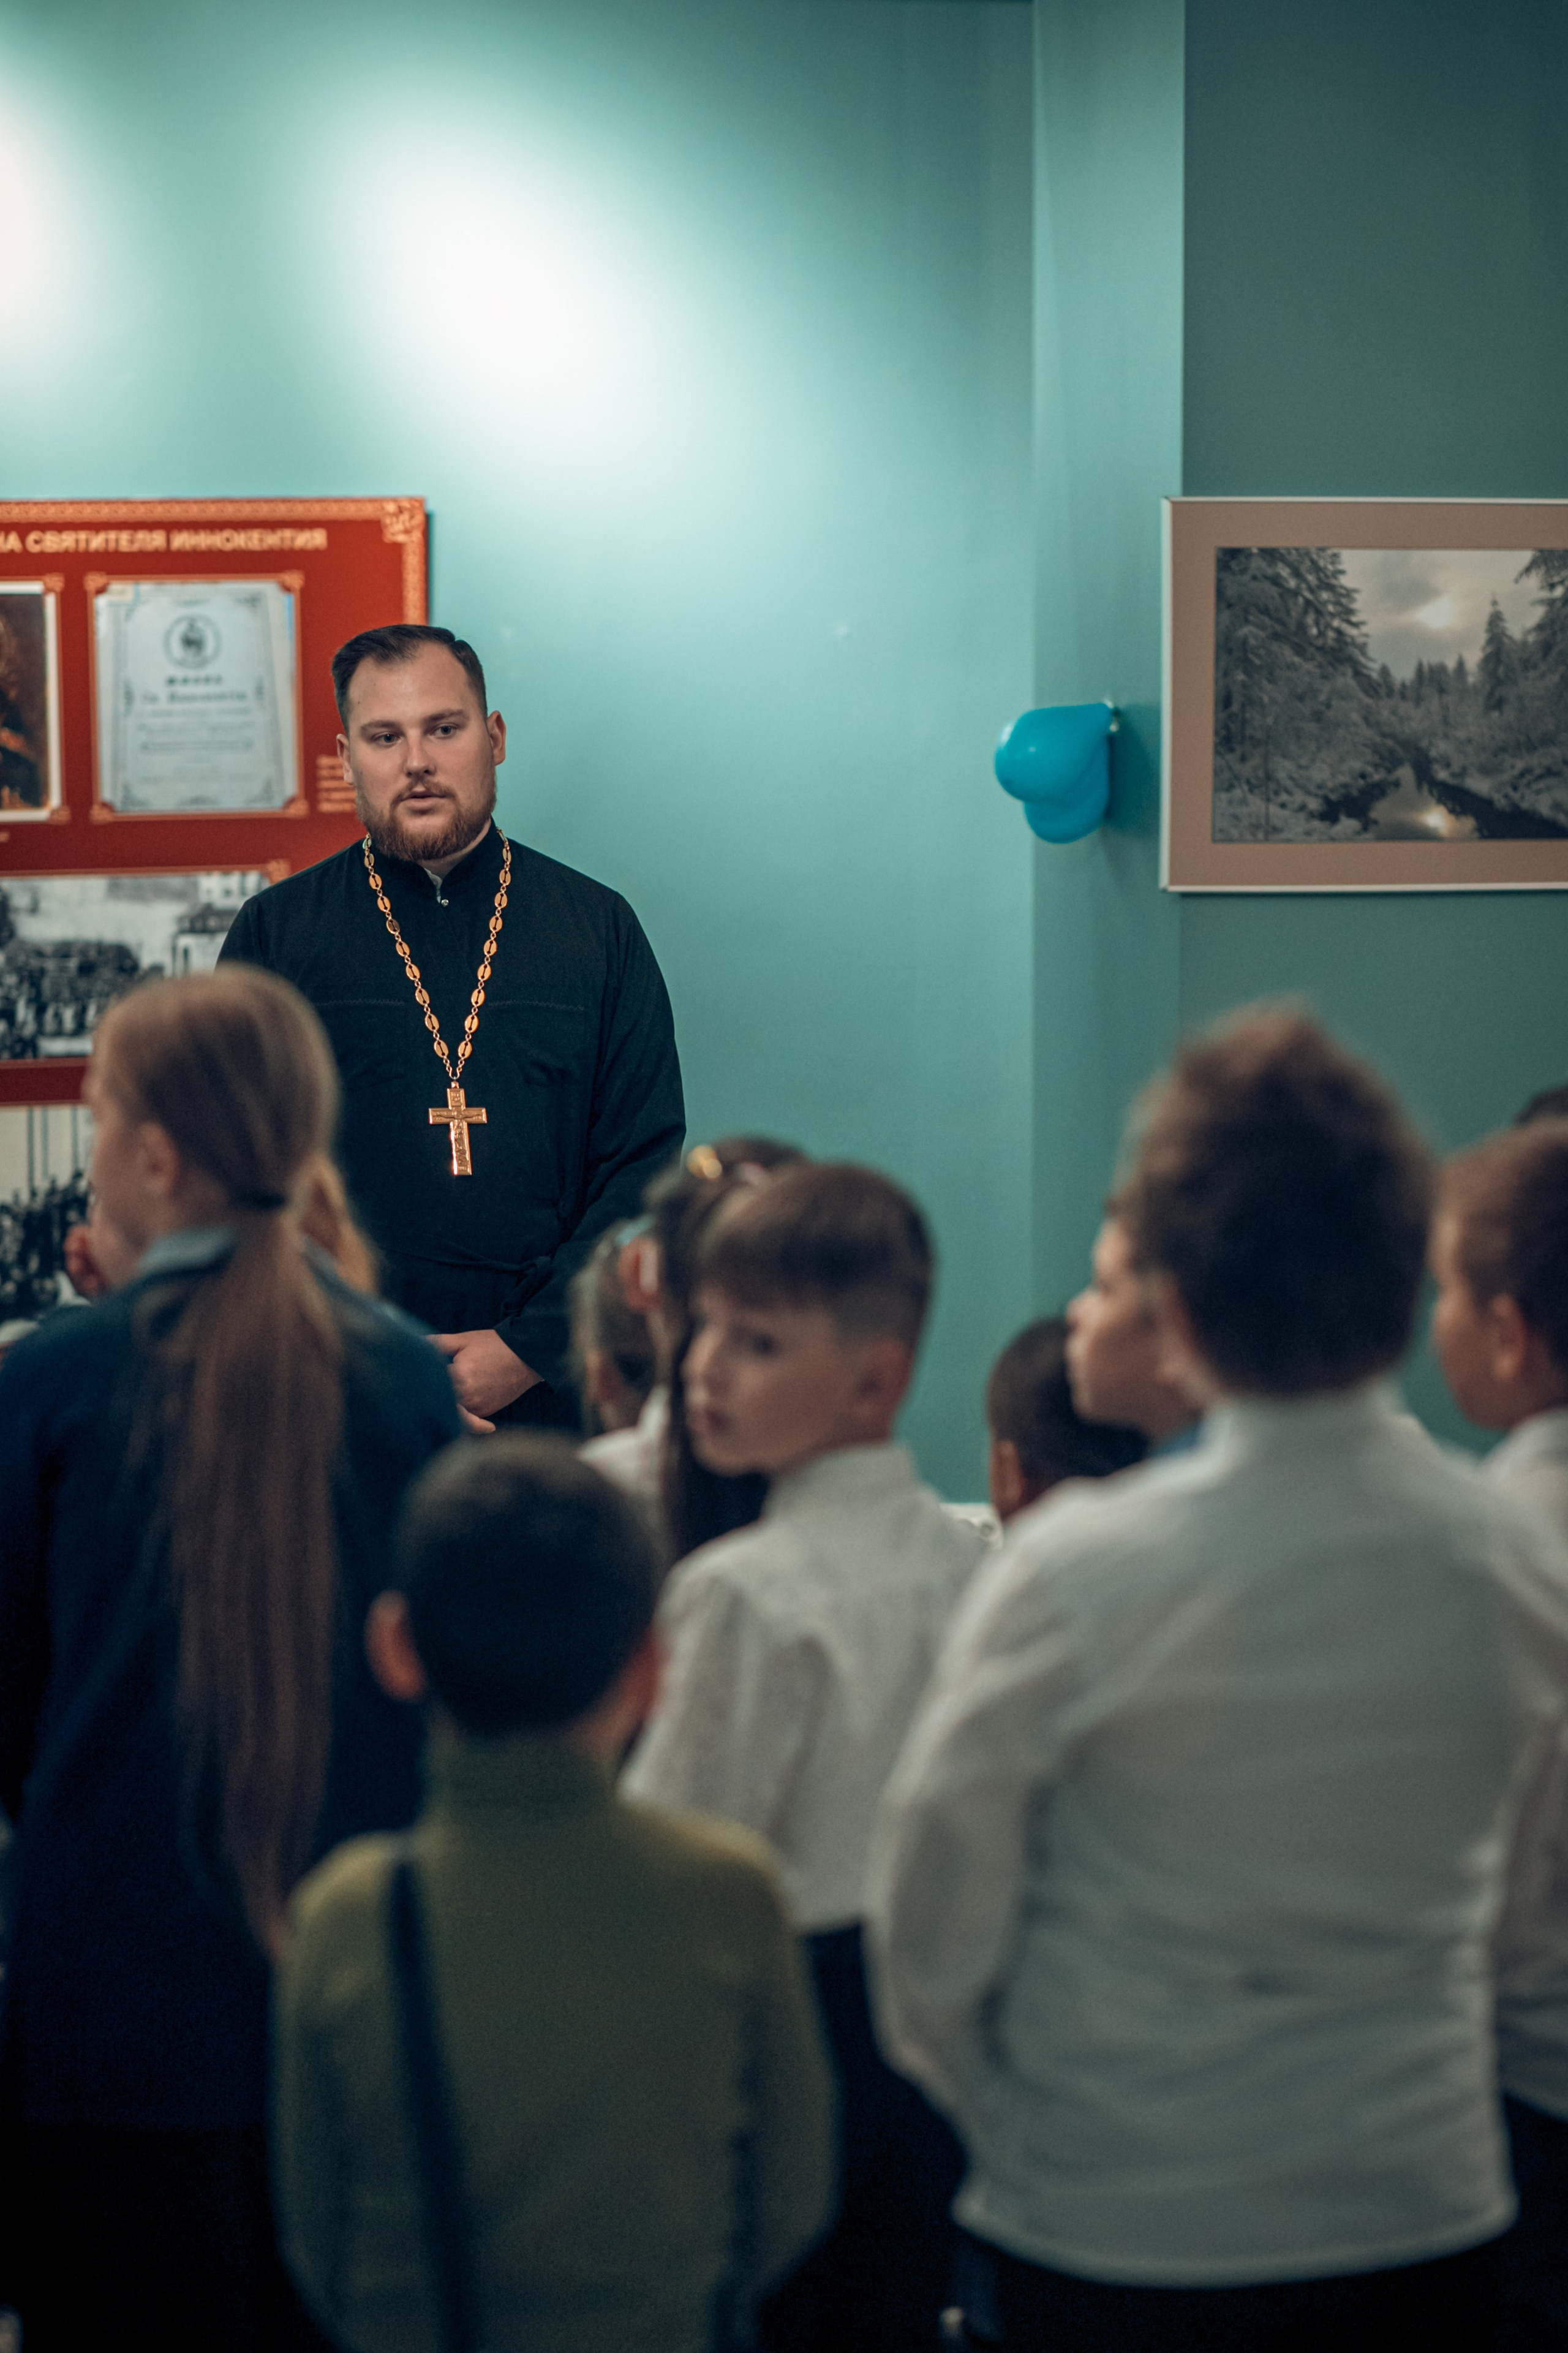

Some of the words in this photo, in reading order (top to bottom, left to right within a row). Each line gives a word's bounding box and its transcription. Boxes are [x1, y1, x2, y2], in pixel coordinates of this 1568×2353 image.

[0, 531, 23, 553] А
[25, 529, 167, 553] СВЯТИТЕЛЯ
[170, 528, 328, 551] ИННОКЕНТИЯ
